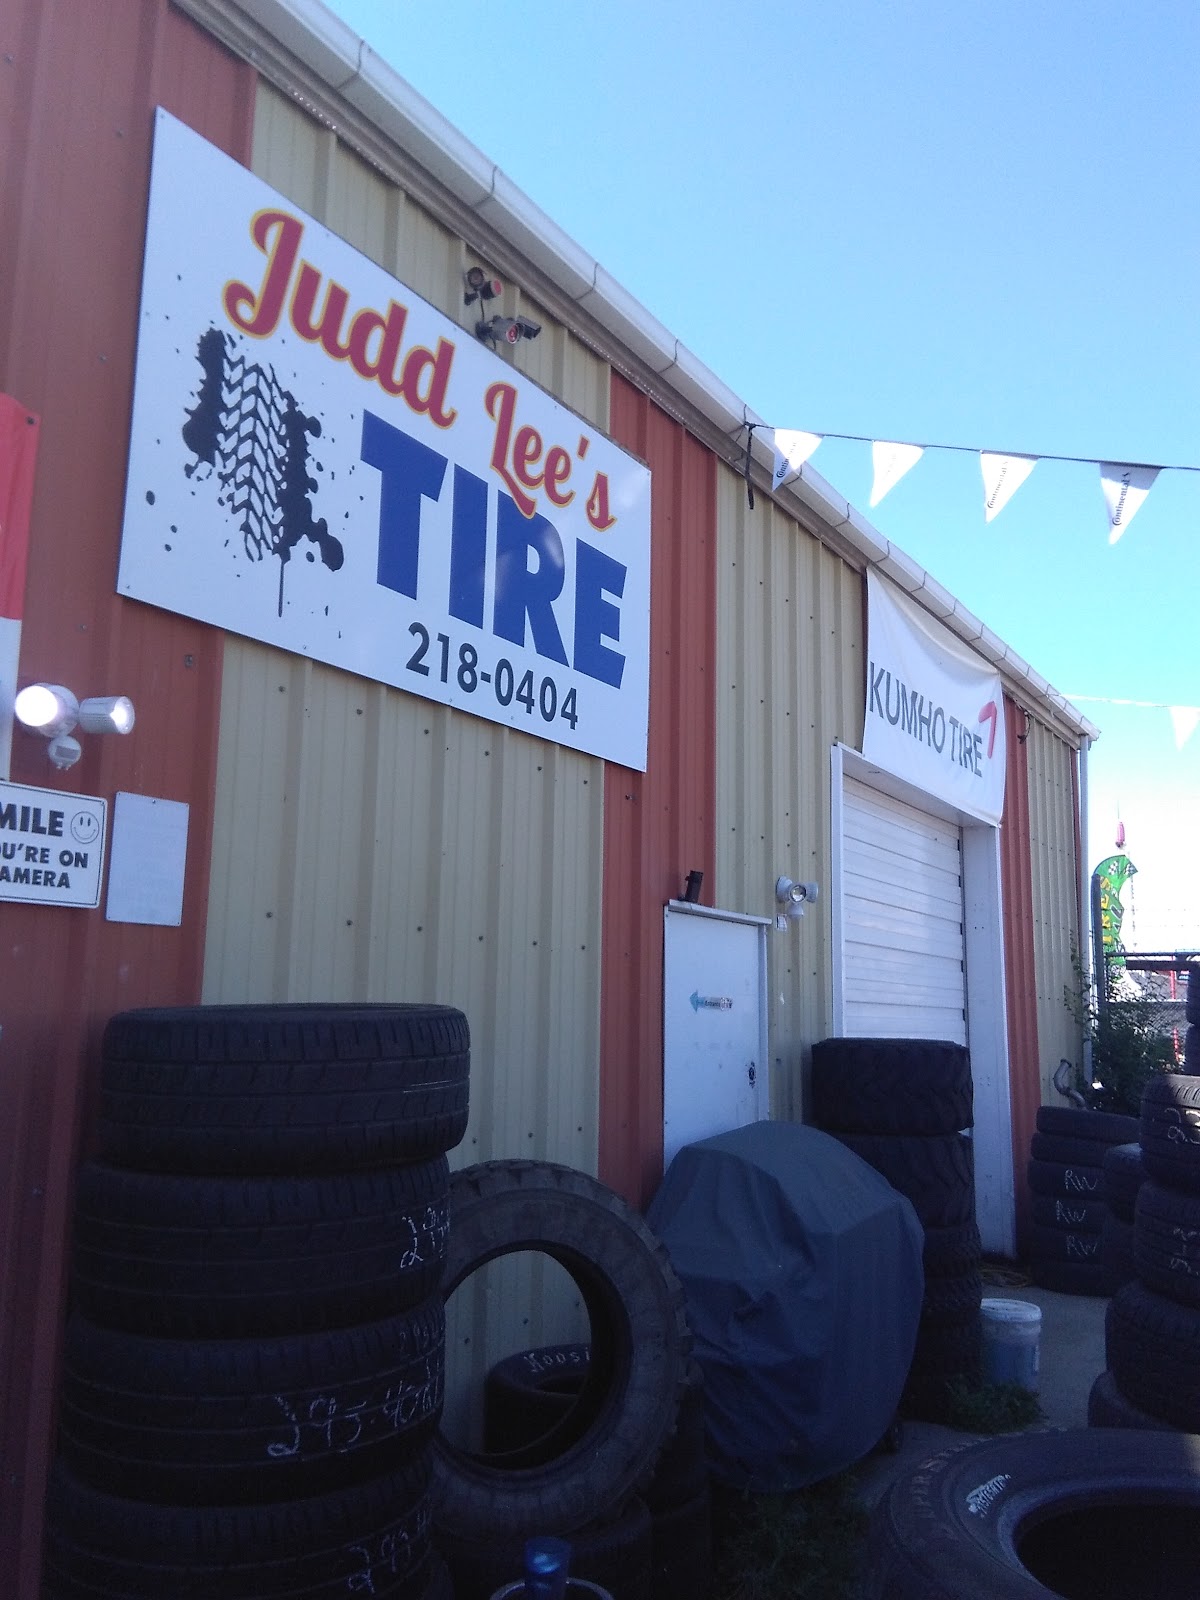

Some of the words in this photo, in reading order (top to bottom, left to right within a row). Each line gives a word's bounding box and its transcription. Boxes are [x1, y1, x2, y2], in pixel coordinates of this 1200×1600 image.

[222, 207, 458, 430] Judd
[484, 381, 618, 532] Lee's
[360, 408, 627, 690] TIRE
[1112, 479, 1131, 526] Continental
[406, 620, 580, 730] 218-0404
[869, 660, 946, 754] KUMHO
[948, 715, 983, 778] TIRE
[0, 842, 51, 864] U'RE
[58, 849, 89, 869] ON
